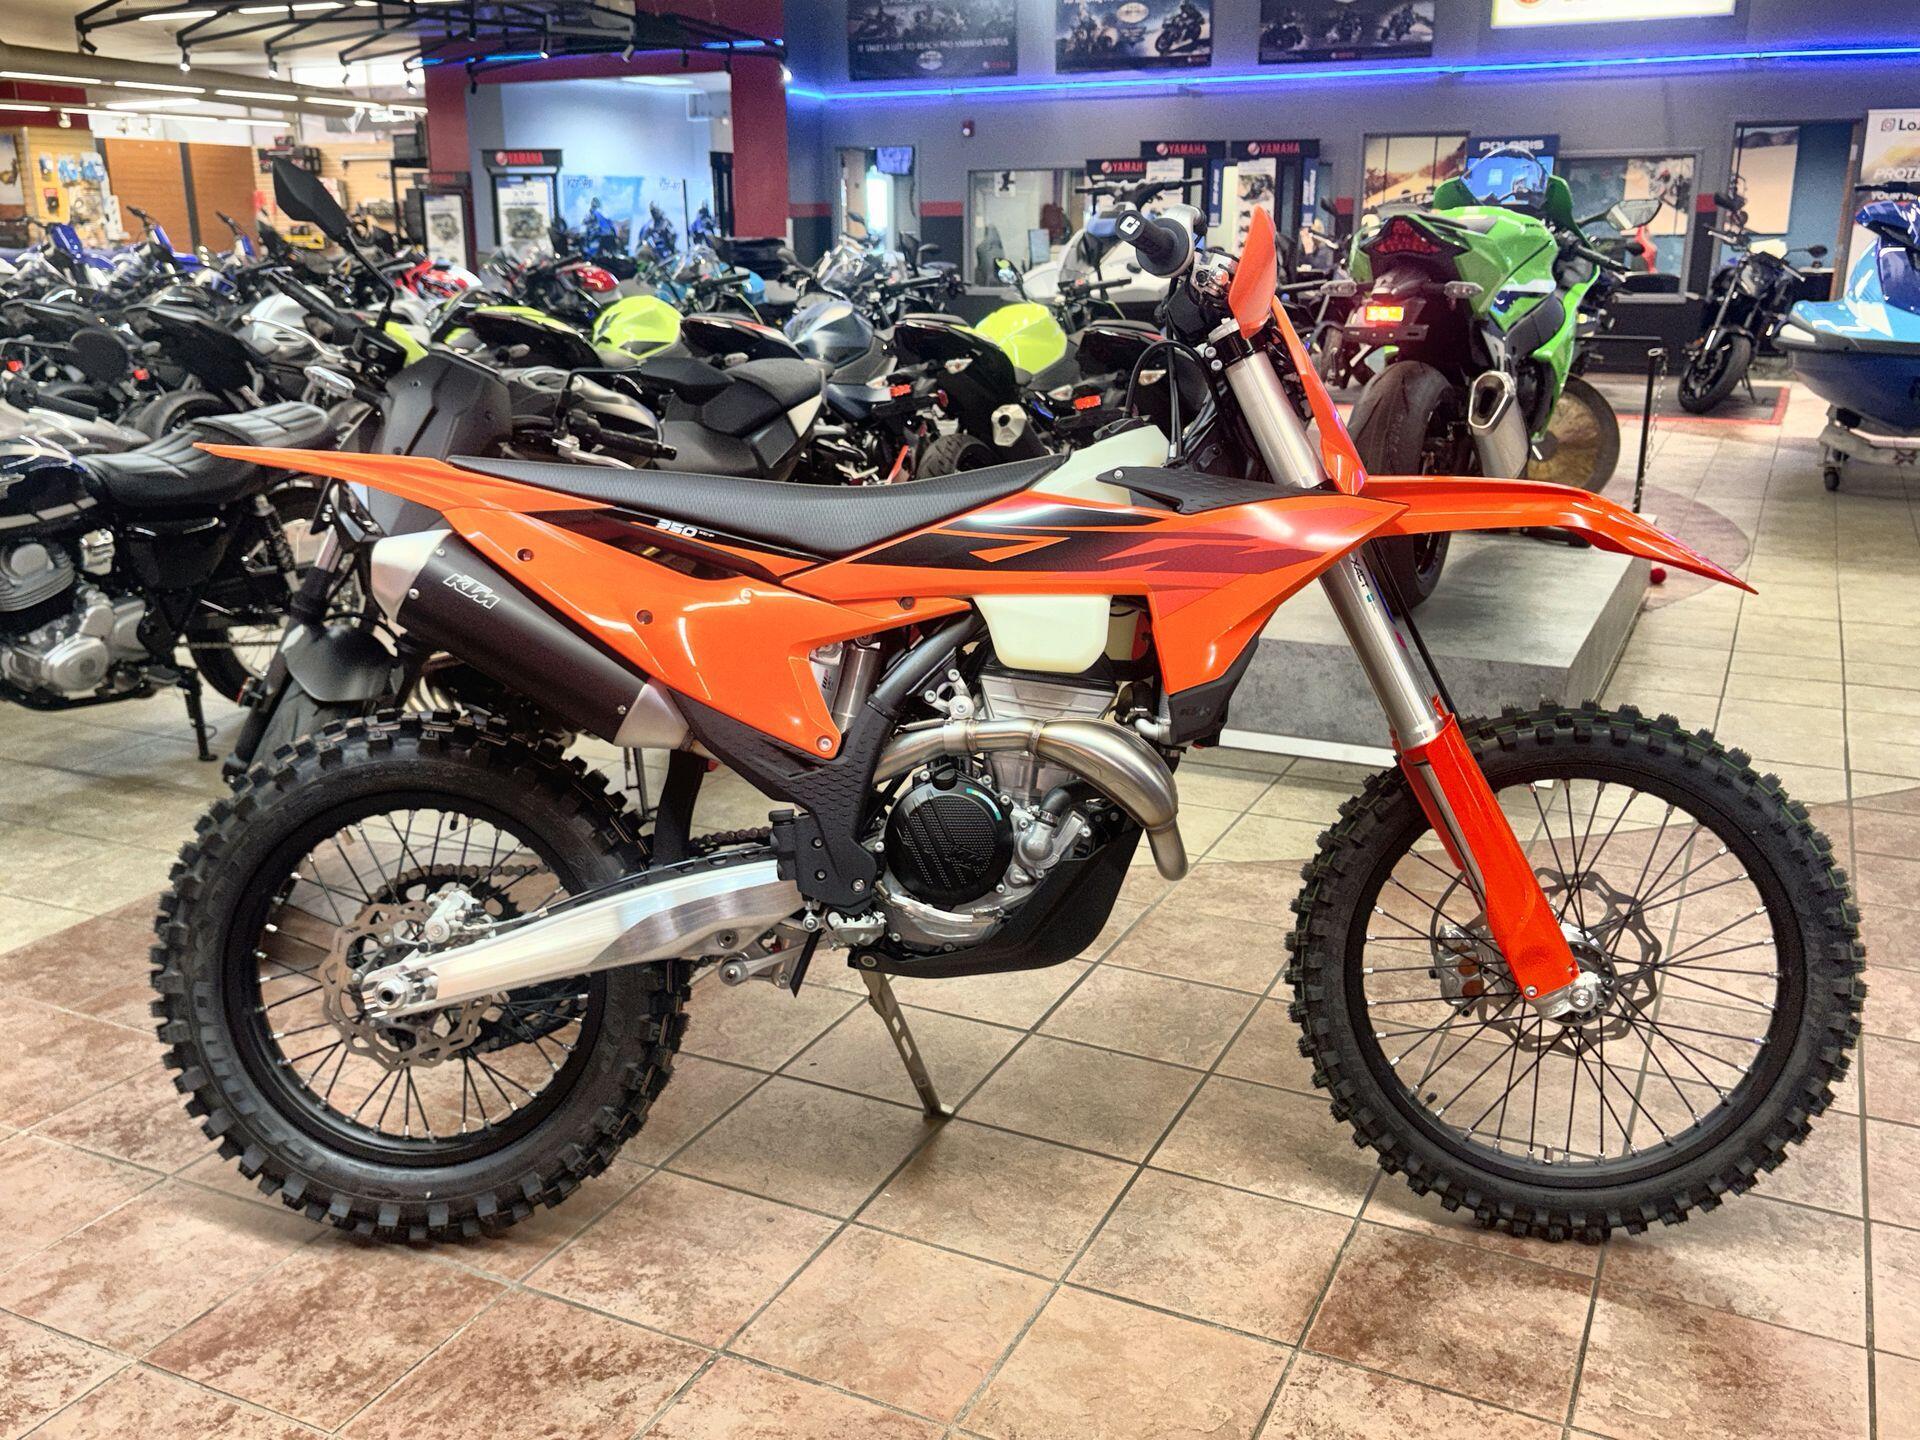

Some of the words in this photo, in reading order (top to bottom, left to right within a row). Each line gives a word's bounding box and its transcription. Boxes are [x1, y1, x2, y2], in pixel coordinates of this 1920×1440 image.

[1168, 143, 1207, 154] YAMAHA
[1260, 142, 1300, 153] YAMAHA
[1112, 162, 1146, 173] YAMAH
[656, 519, 698, 537] 350
[1351, 558, 1369, 587] XACT
[443, 573, 500, 609] KTM
